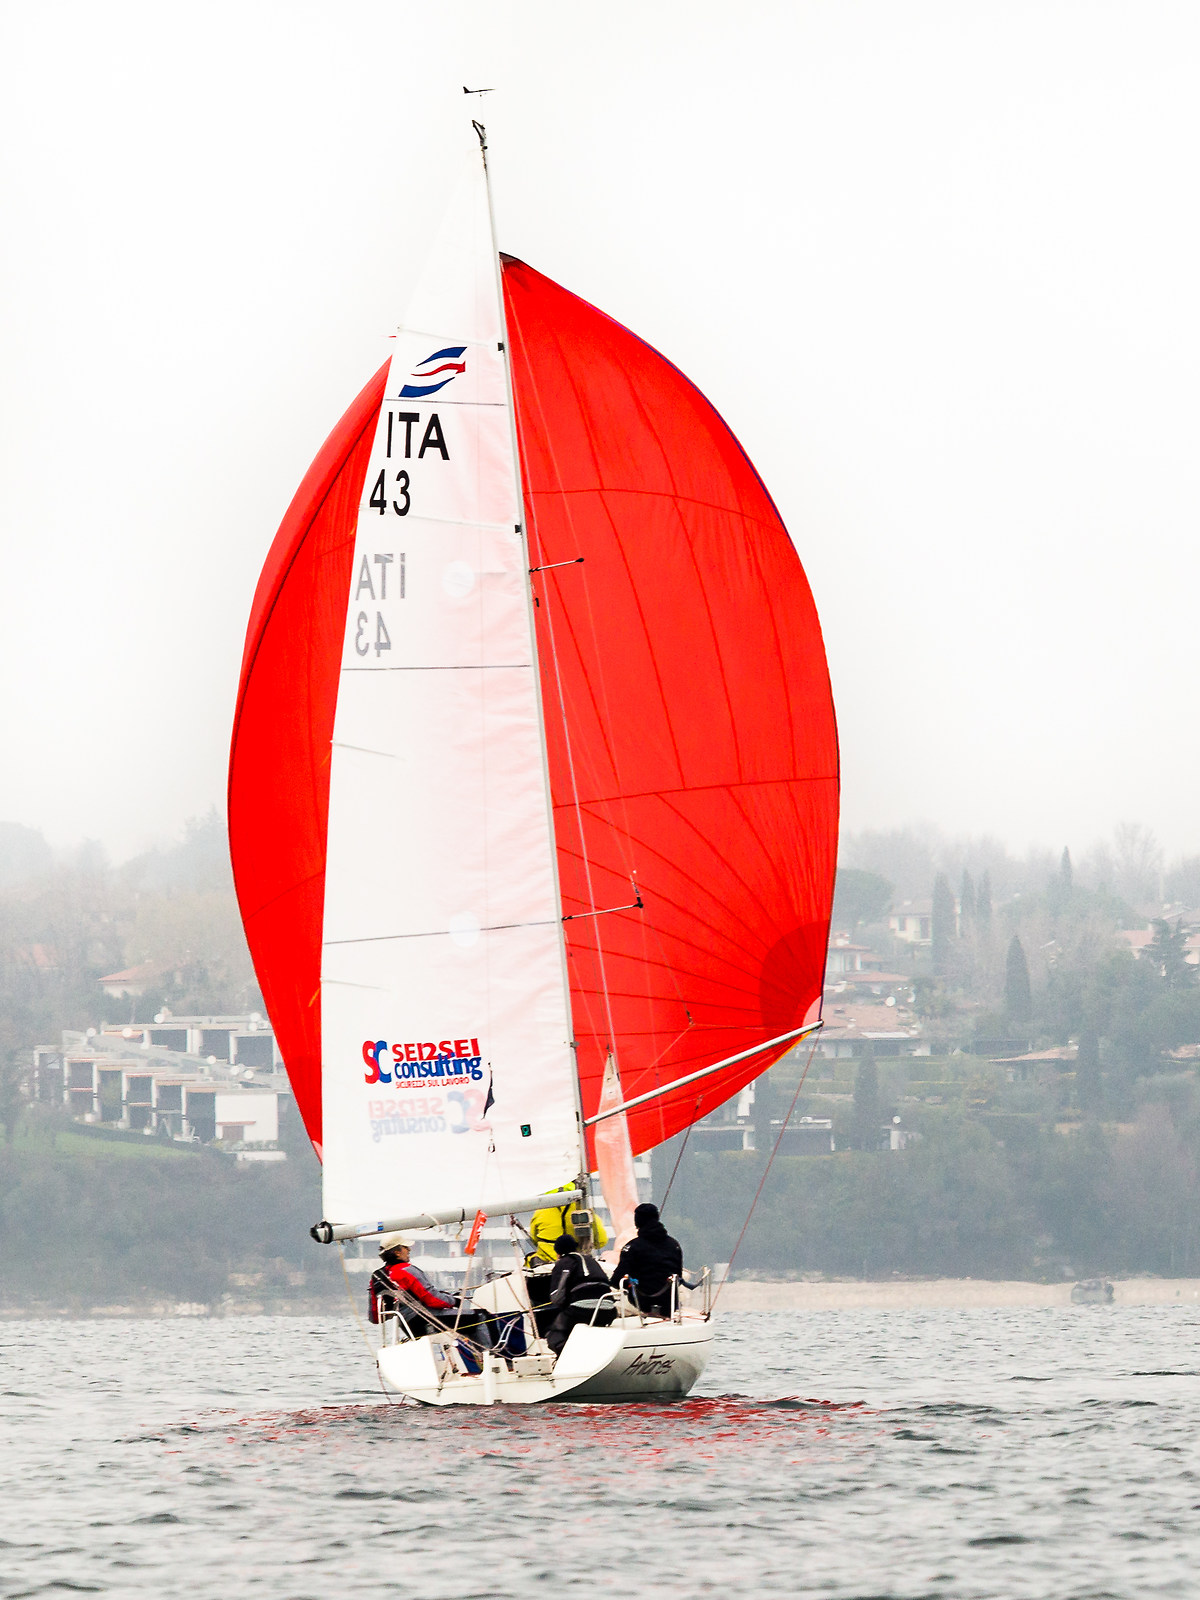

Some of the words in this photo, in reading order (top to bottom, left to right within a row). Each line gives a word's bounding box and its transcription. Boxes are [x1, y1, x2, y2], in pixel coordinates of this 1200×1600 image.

[387, 412, 450, 460] ITA
[369, 469, 411, 516] 43
[428, 1079, 440, 1087] SUL
[441, 1076, 470, 1087] LAVORO
